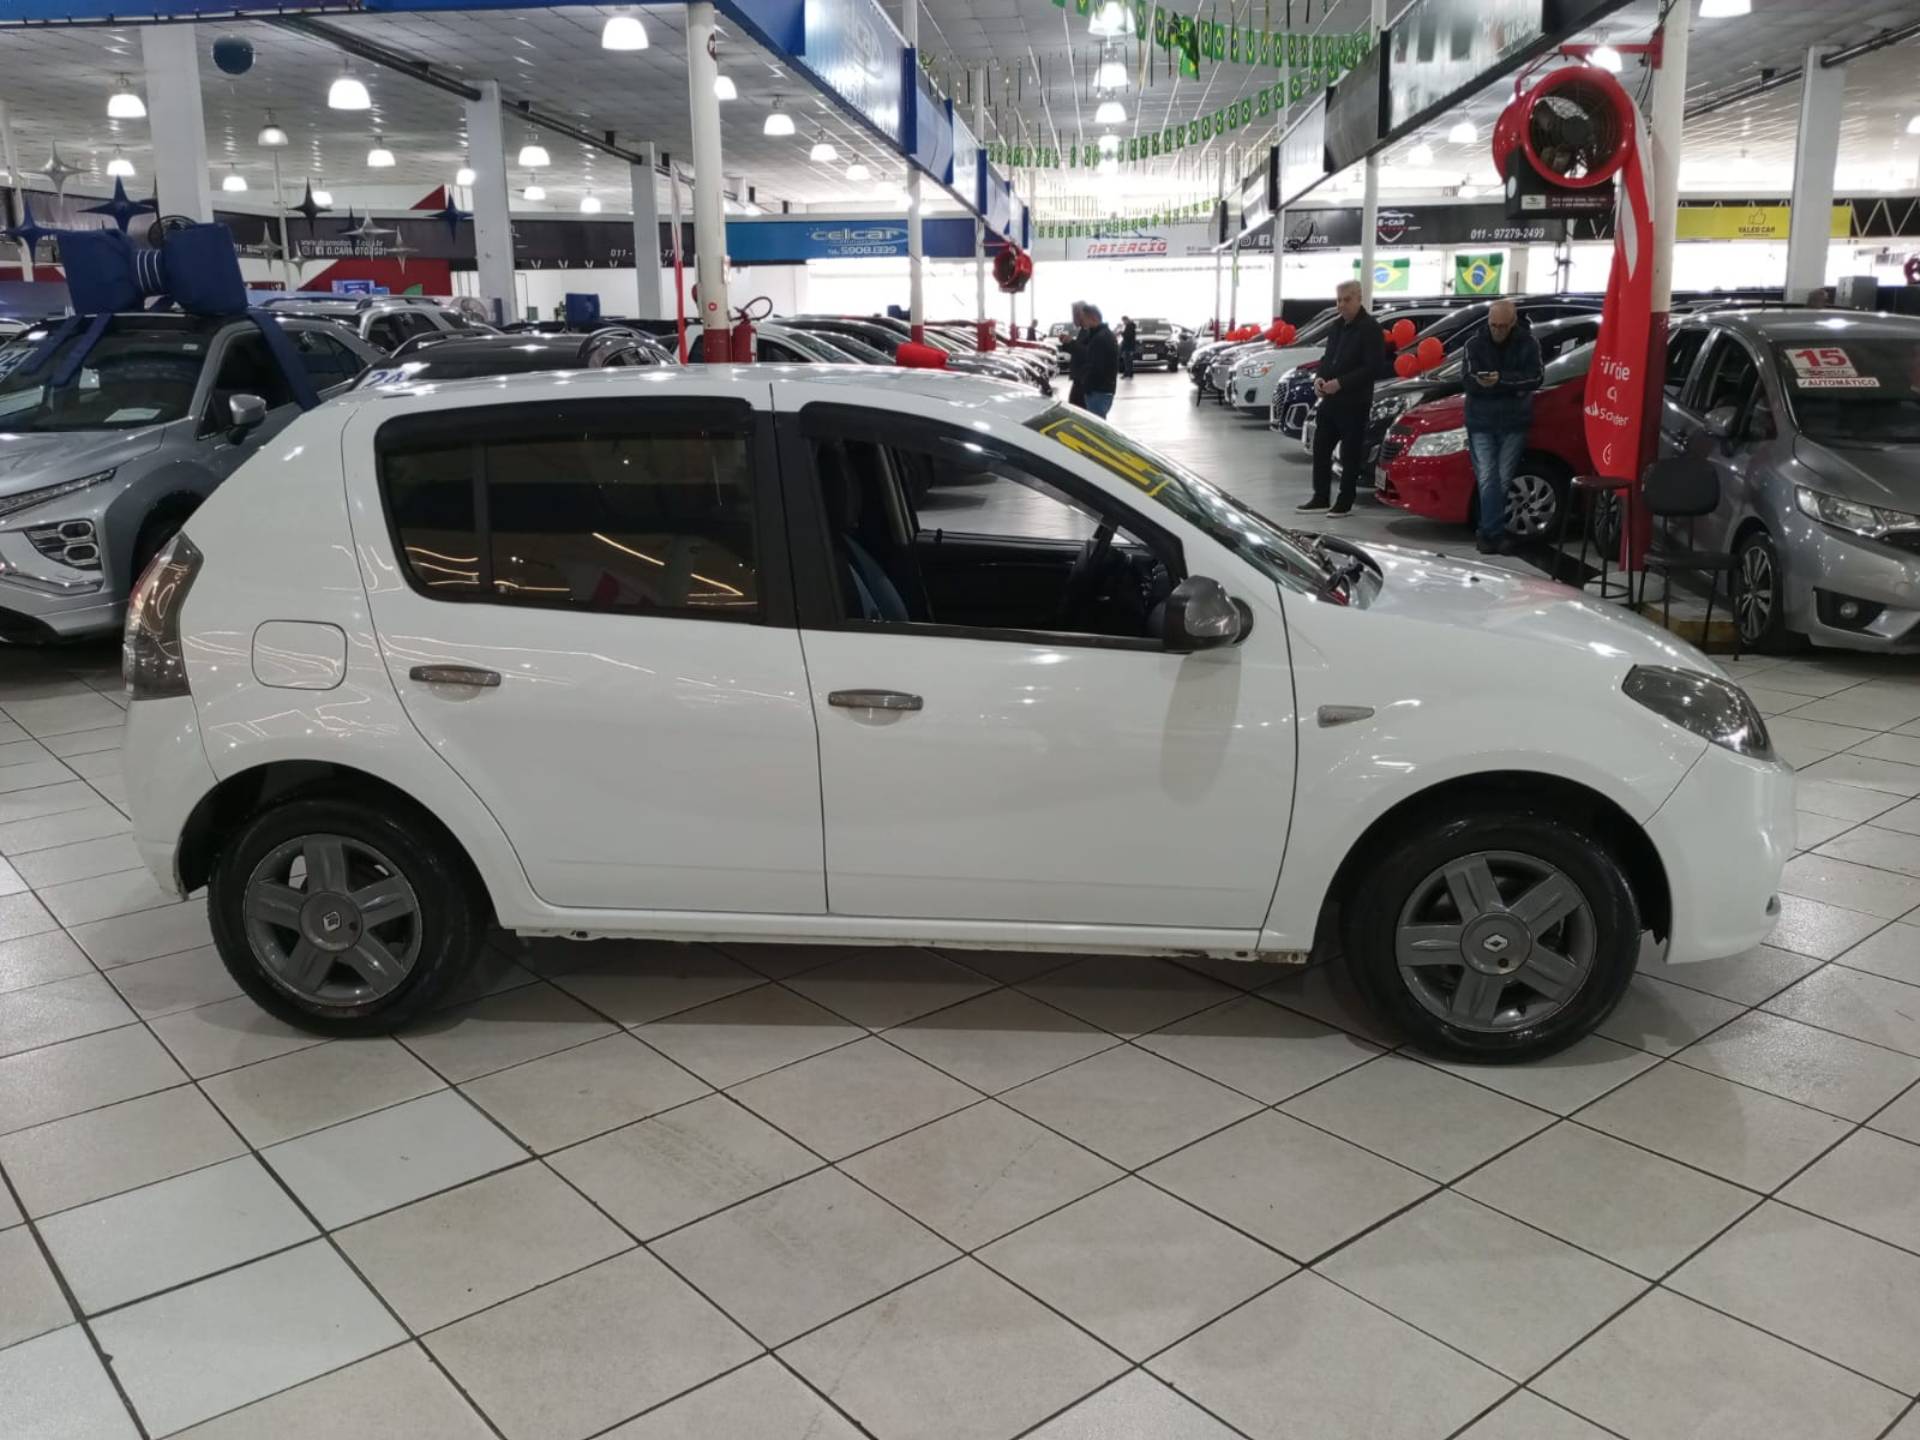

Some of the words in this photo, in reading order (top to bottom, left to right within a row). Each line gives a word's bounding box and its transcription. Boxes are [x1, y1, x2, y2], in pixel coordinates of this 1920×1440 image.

[811, 228, 900, 241] celcar
[1470, 228, 1486, 240] 011
[1795, 349, 1847, 367] 15
